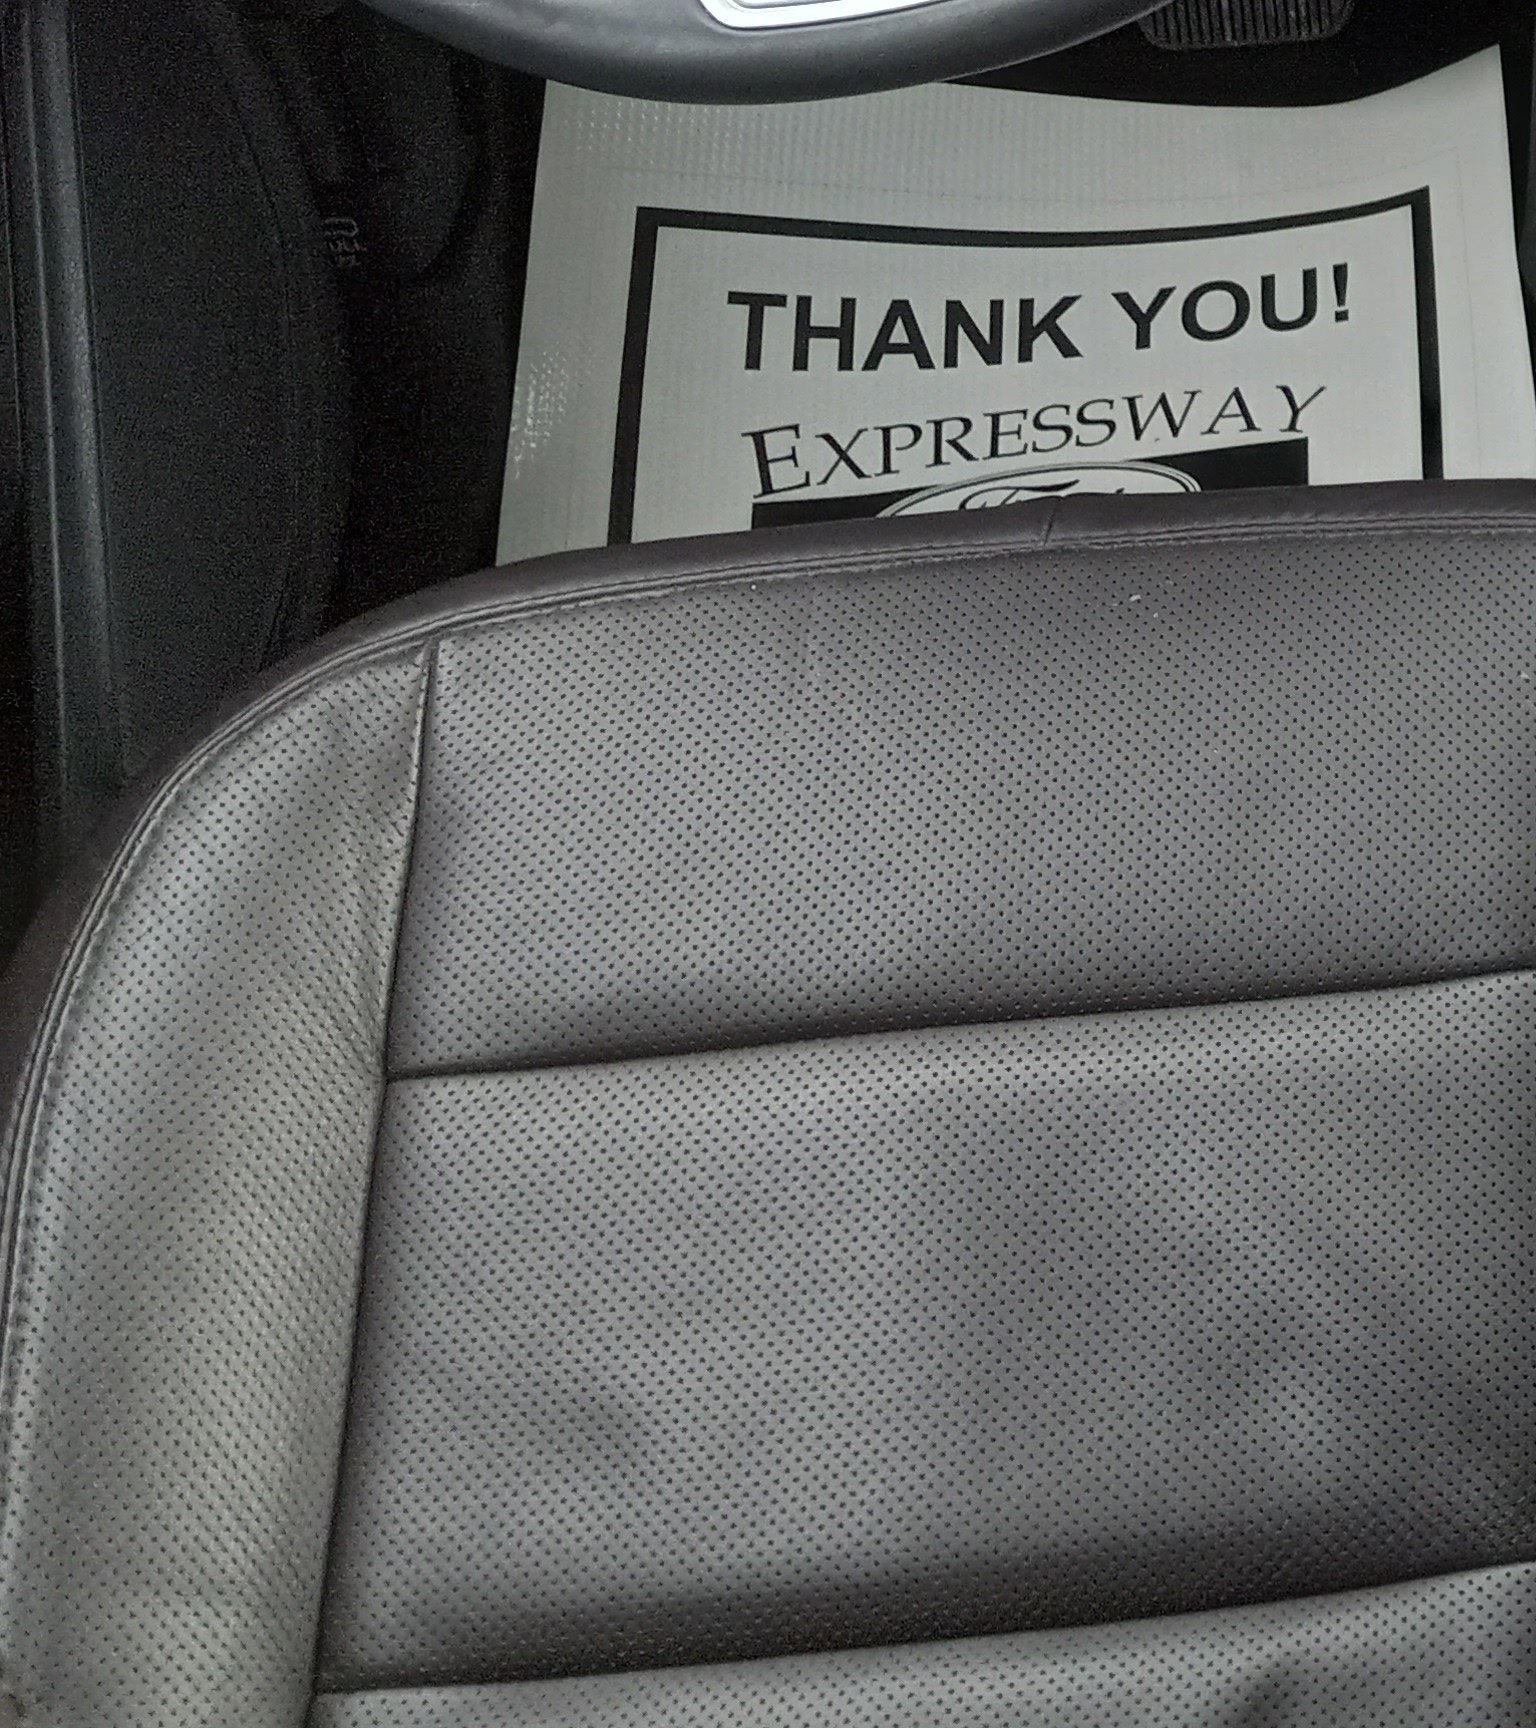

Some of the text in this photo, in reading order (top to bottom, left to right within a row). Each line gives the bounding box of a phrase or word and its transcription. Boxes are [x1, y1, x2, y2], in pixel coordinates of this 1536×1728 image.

[726, 263, 1350, 373] THANK YOU!
[740, 385, 1328, 499] EXPRESSWAY
